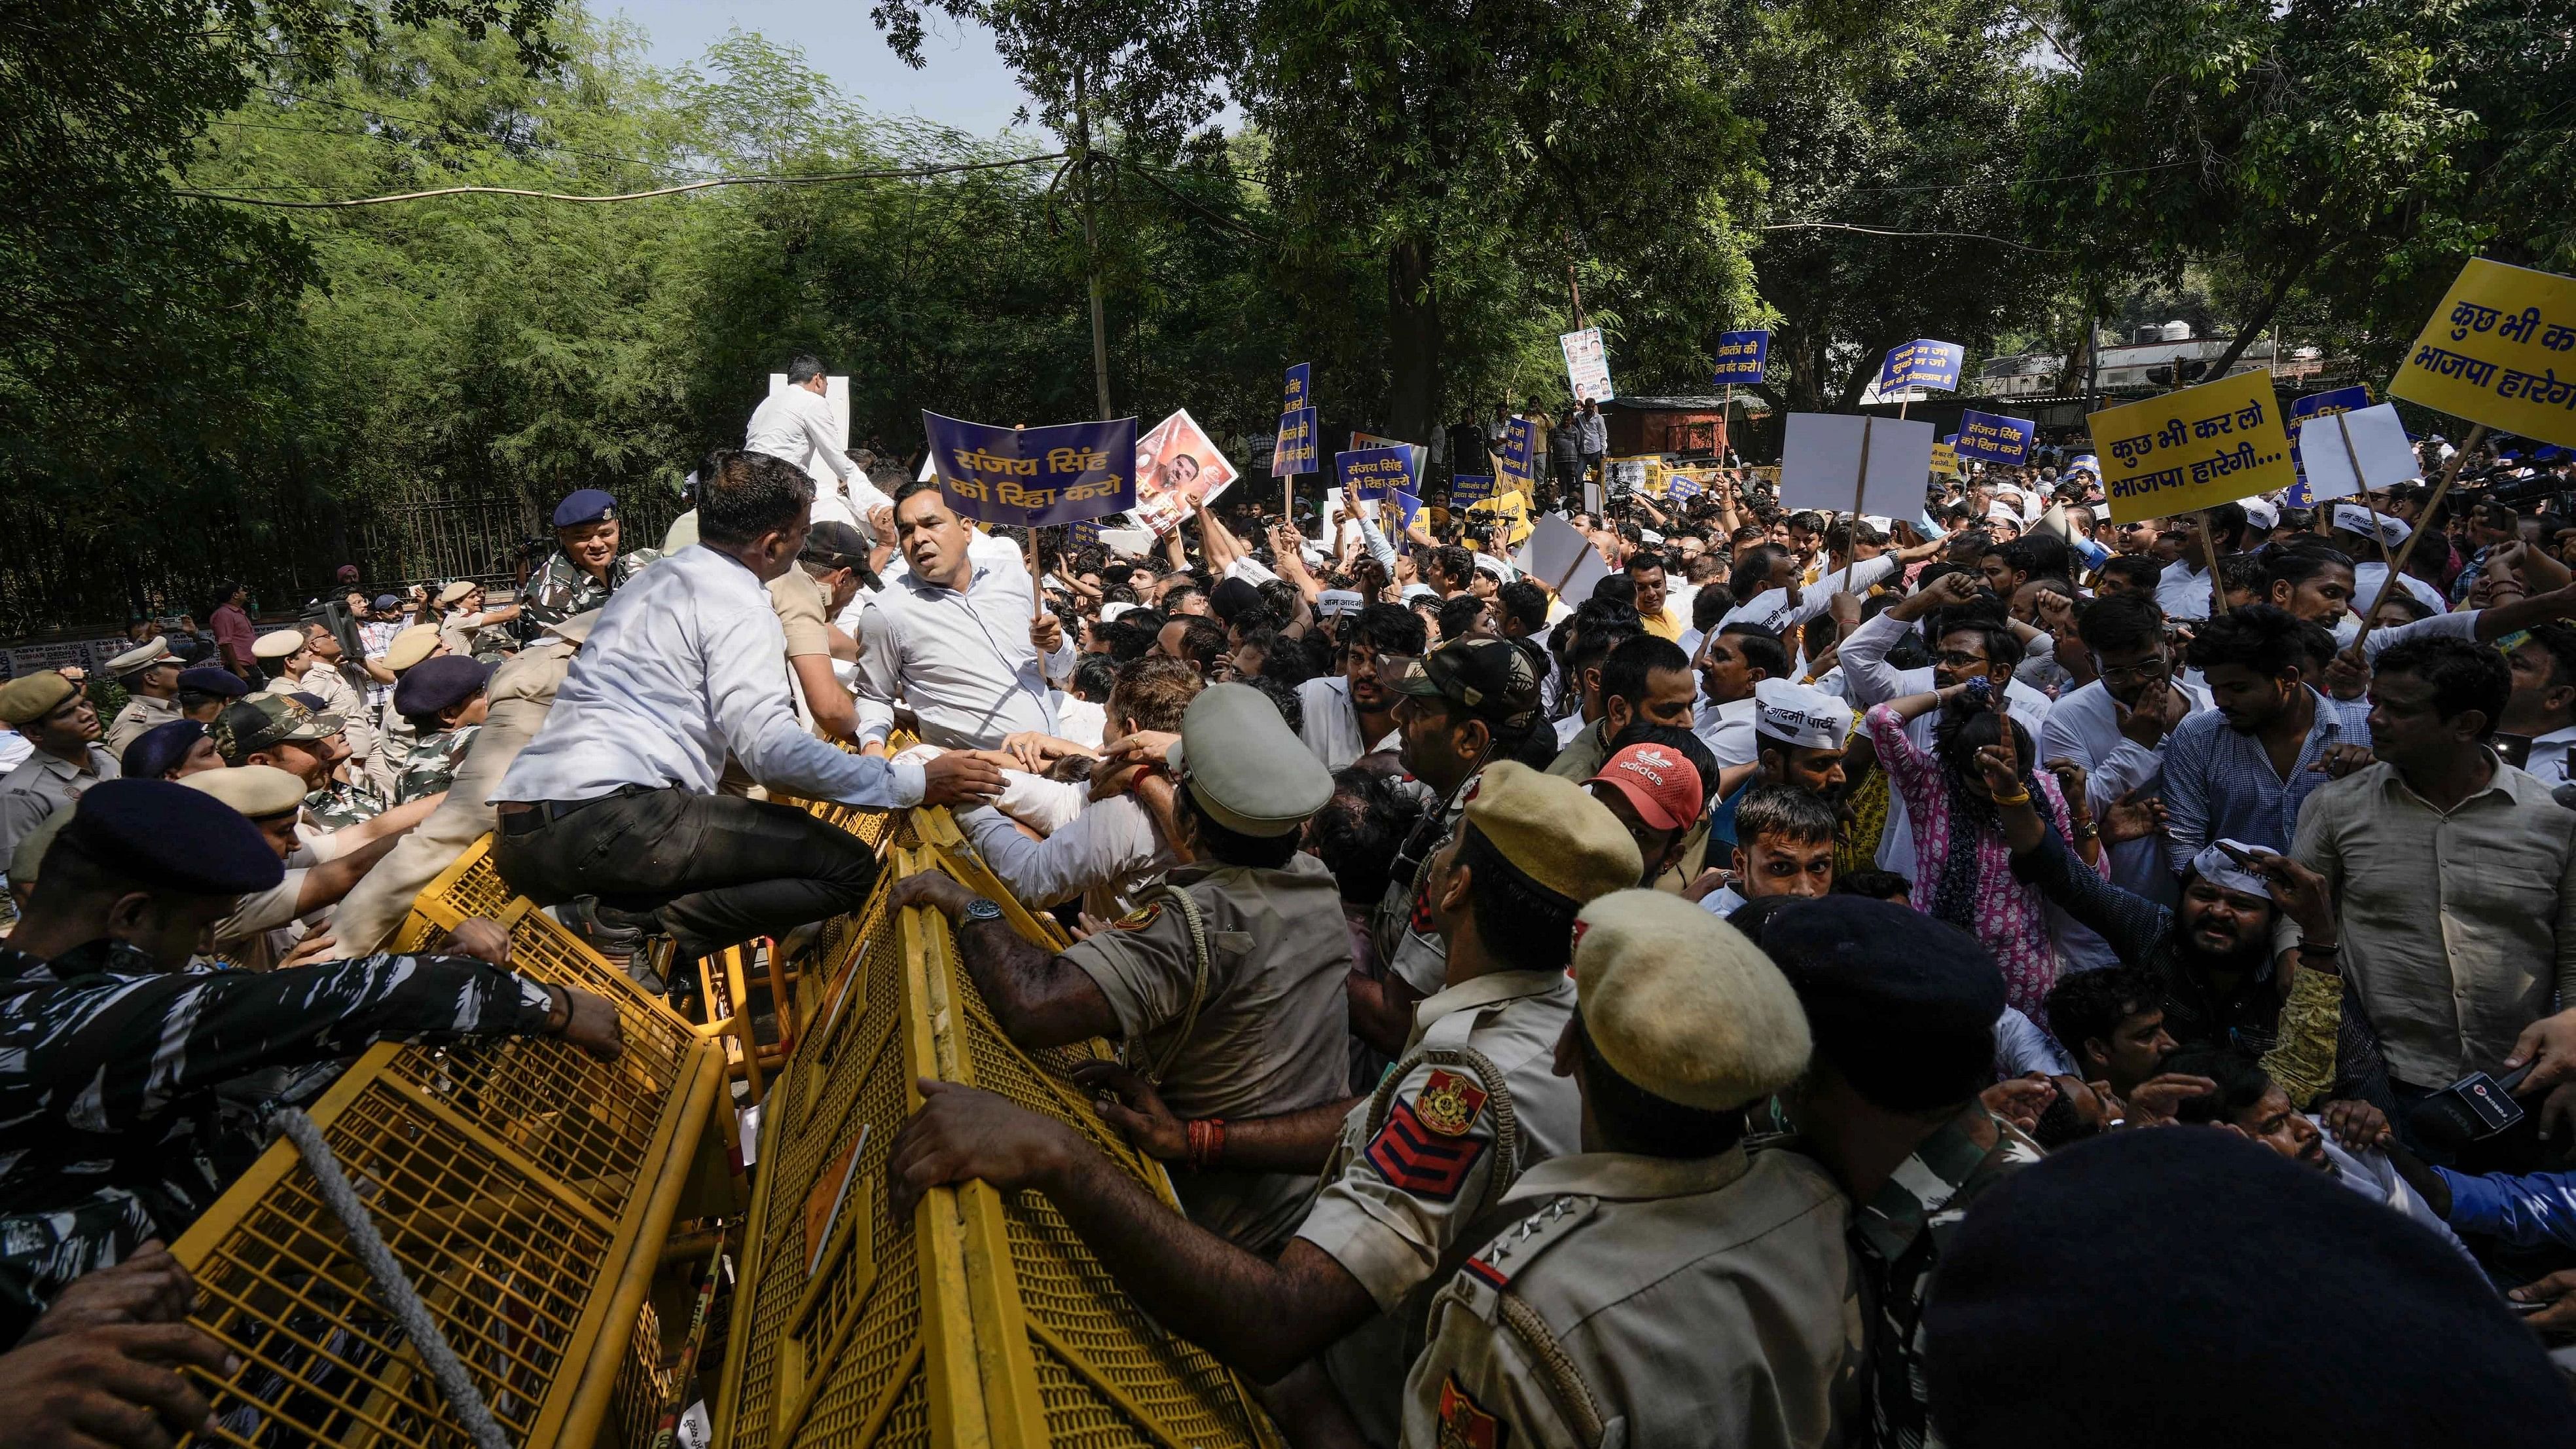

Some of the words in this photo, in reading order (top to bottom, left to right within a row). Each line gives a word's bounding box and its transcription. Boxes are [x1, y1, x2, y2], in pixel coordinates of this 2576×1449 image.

[2450, 301, 2502, 341] कुछ
[2499, 307, 2541, 344] भी
[2541, 324, 2576, 351] क
[1719, 342, 1742, 357] लोकतंत्र
[1744, 340, 1758, 354] की
[1931, 346, 1950, 356] जो
[1892, 358, 1913, 374] झुके
[1928, 358, 1947, 367] जो
[1289, 378, 1301, 393] सिंह
[1883, 378, 1895, 390] हम
[1896, 374, 1906, 384] वो
[2414, 345, 2498, 388] भाजपा
[2497, 368, 2576, 411] हारेग
[1291, 395, 1303, 411] करो
[1298, 421, 1309, 438] की
[1515, 426, 1525, 439] जो
[1968, 422, 1998, 437] संजय
[1999, 427, 2023, 441] सिंह
[2109, 433, 2152, 469] कुछ
[2157, 418, 2188, 449] भी
[2192, 413, 2232, 439] कर
[2234, 398, 2264, 430] लो
[1514, 440, 1523, 452] जो
[1961, 436, 1976, 447] को
[1978, 437, 1999, 451] रिहा
[2000, 445, 2023, 456] करो
[953, 448, 1039, 476] संजय
[1046, 447, 1110, 474] सिंह
[1347, 462, 1377, 475] संजय
[1380, 459, 1403, 472] सिंह
[1364, 477, 1385, 489] रिहा
[1388, 474, 1409, 487] करो
[2111, 466, 2185, 498] भाजपा
[949, 477, 988, 502] को
[996, 482, 1056, 509] रिहा
[1063, 473, 1123, 501] करो
[1340, 598, 1364, 608] आदमी
[1768, 705, 1805, 724] आदमी
[1807, 715, 1836, 729] पार्टी
[1619, 759, 1663, 786] adidas
[2484, 1095, 2508, 1118] FORUM
